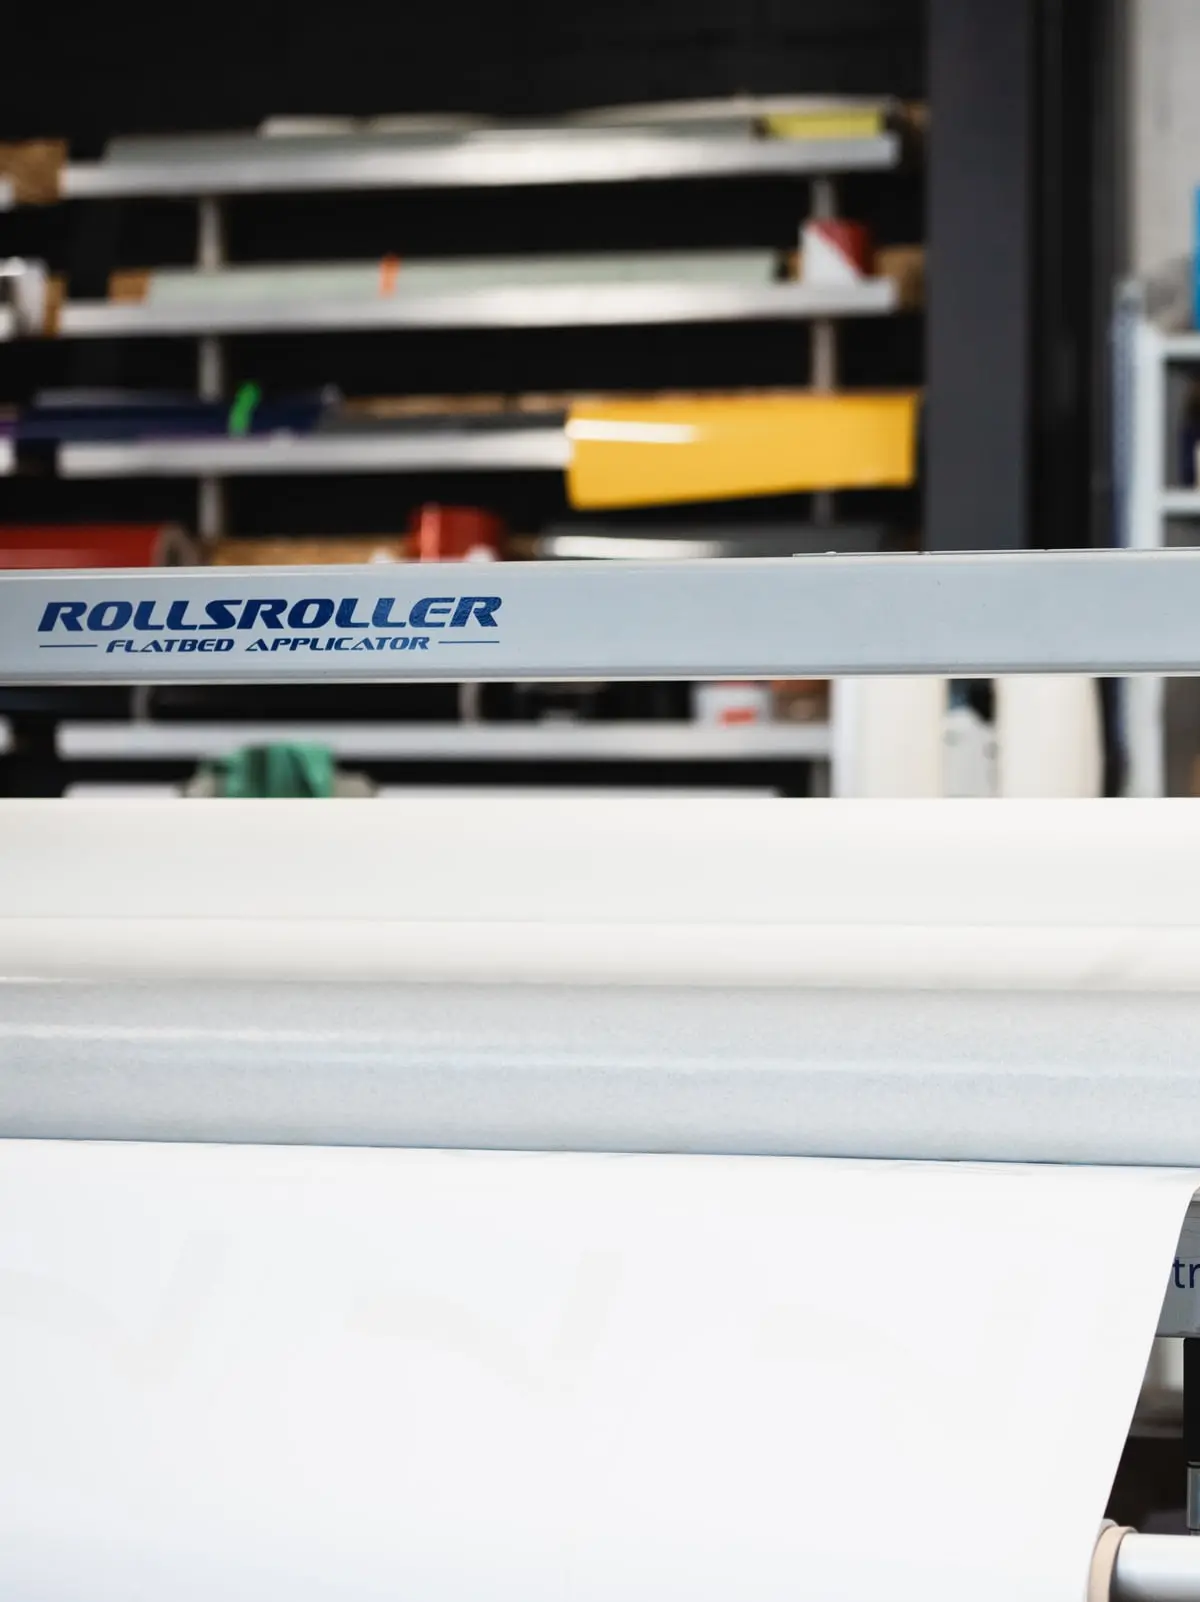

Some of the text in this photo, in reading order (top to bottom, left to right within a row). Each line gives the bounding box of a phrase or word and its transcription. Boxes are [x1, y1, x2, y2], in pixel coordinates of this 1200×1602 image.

[37, 596, 503, 632] ROLLSROLLER
[105, 636, 430, 653] FLATBED APPLICATOR
